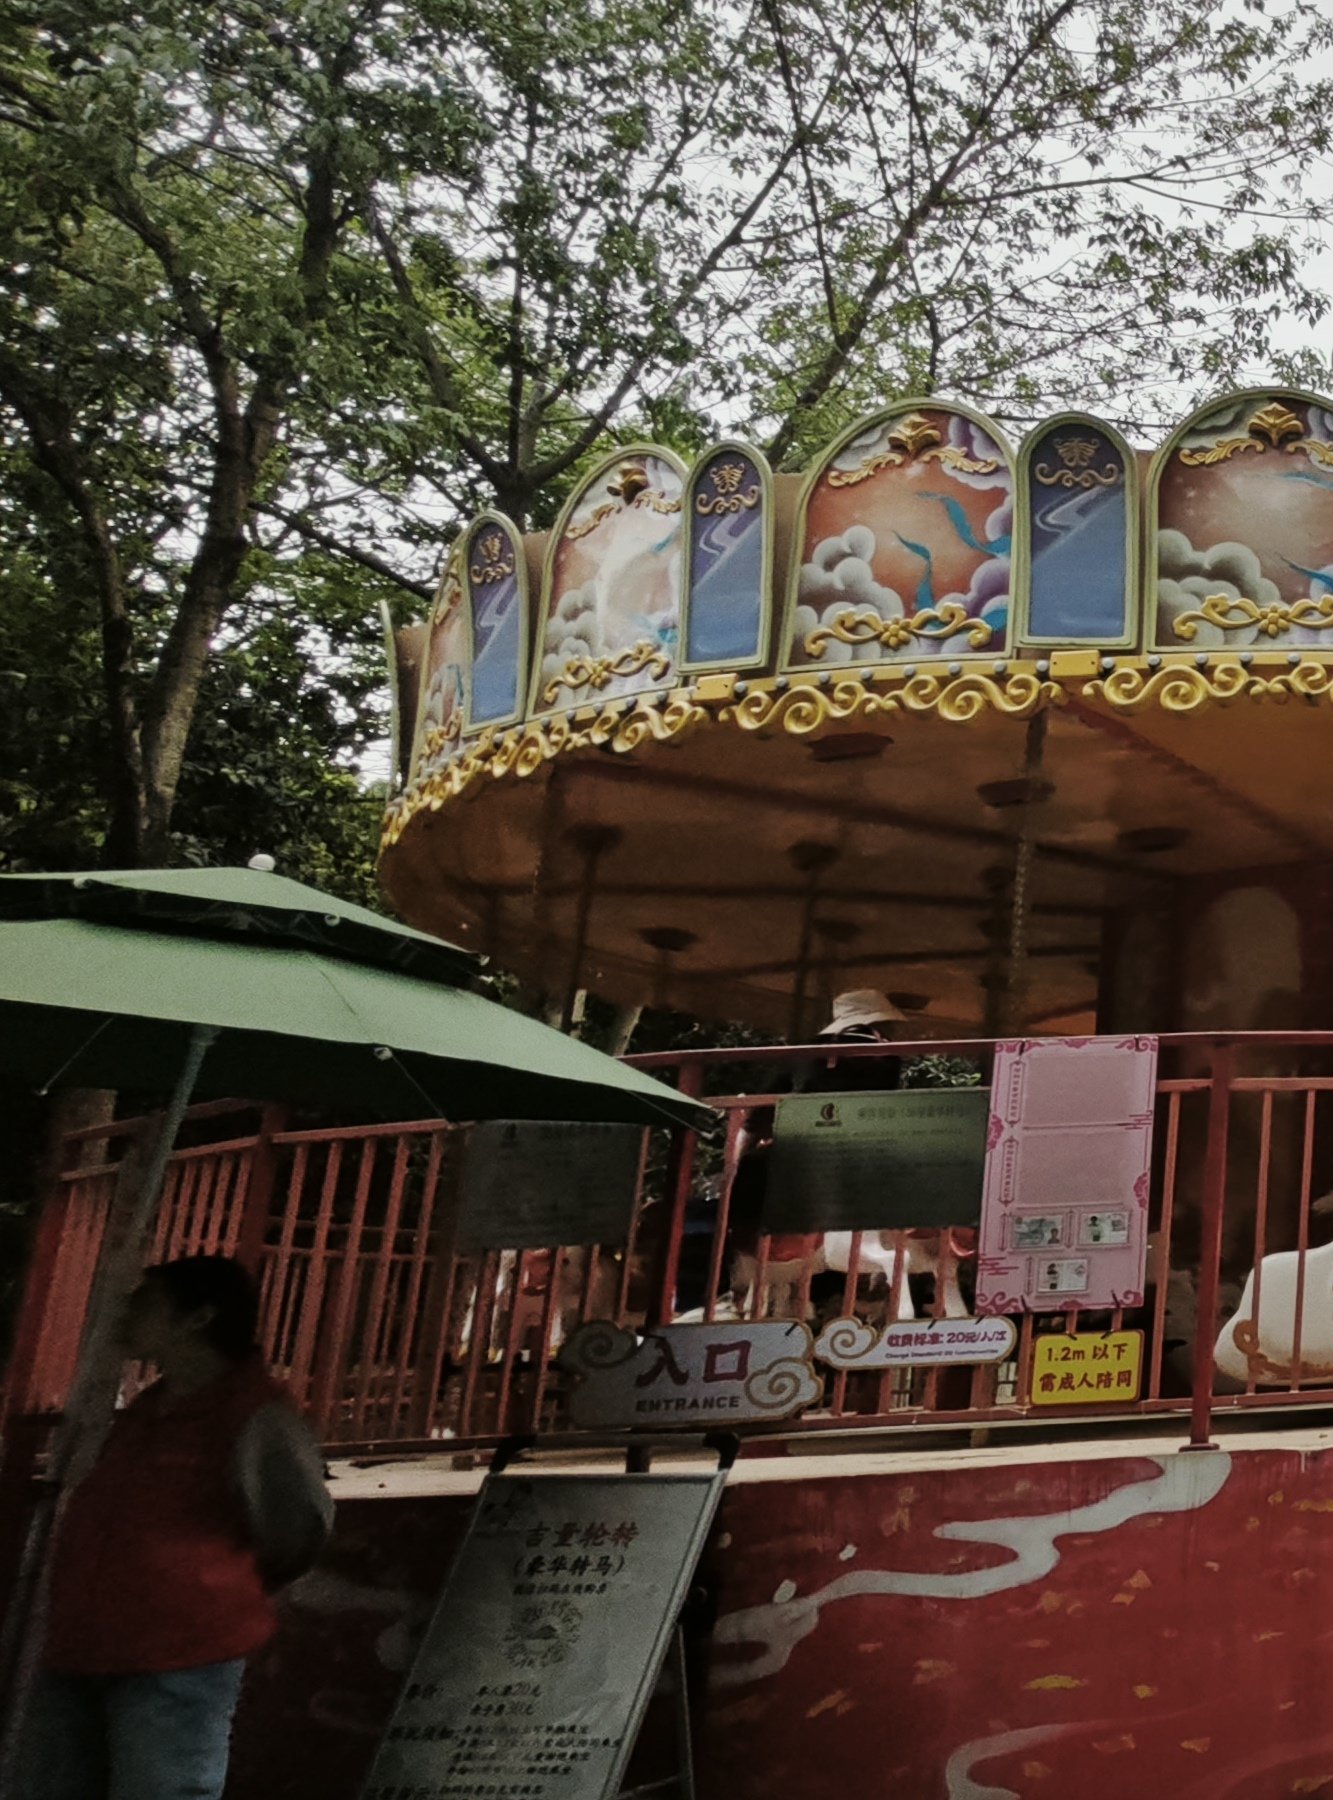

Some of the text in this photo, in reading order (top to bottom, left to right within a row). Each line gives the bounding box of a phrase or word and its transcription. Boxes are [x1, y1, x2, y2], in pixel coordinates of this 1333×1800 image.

[634, 1336, 752, 1388] 入口
[1047, 1343, 1128, 1362] 1.2m 以下
[1039, 1370, 1132, 1393] 需成人陪同
[635, 1396, 740, 1412] ENTRANCE
